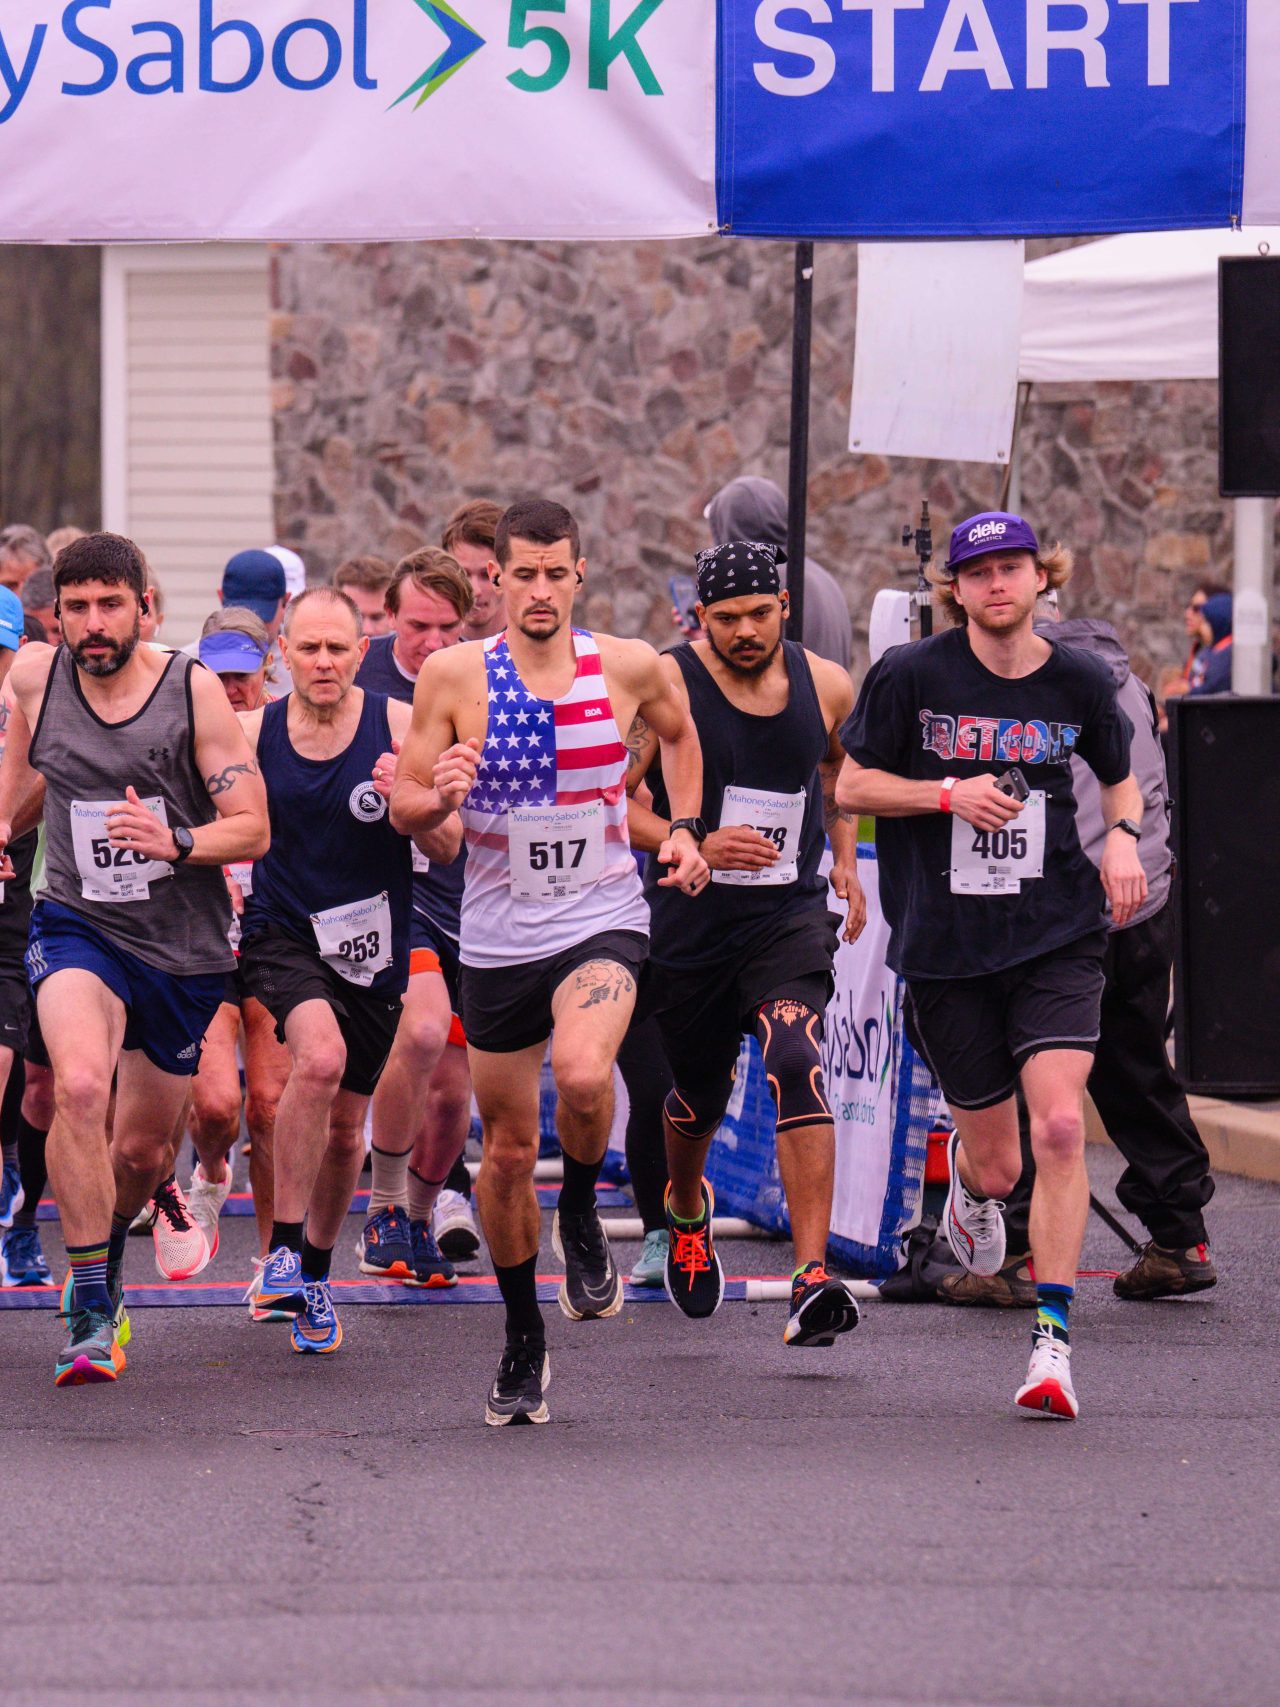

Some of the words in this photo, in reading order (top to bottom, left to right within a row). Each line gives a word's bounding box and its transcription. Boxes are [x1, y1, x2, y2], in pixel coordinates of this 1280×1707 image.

[505, 0, 665, 97] 5K
[752, 0, 1200, 97] START
[918, 709, 1082, 764] DETROIT
[513, 811, 580, 823] MahoneySabol
[587, 808, 599, 817] 5K
[728, 793, 789, 809] MahoneySabol
[529, 838, 587, 870] 517
[740, 823, 788, 853] 78
[971, 828, 1027, 860] 405
[318, 905, 372, 927] MahoneySabol
[339, 930, 380, 963] 253
